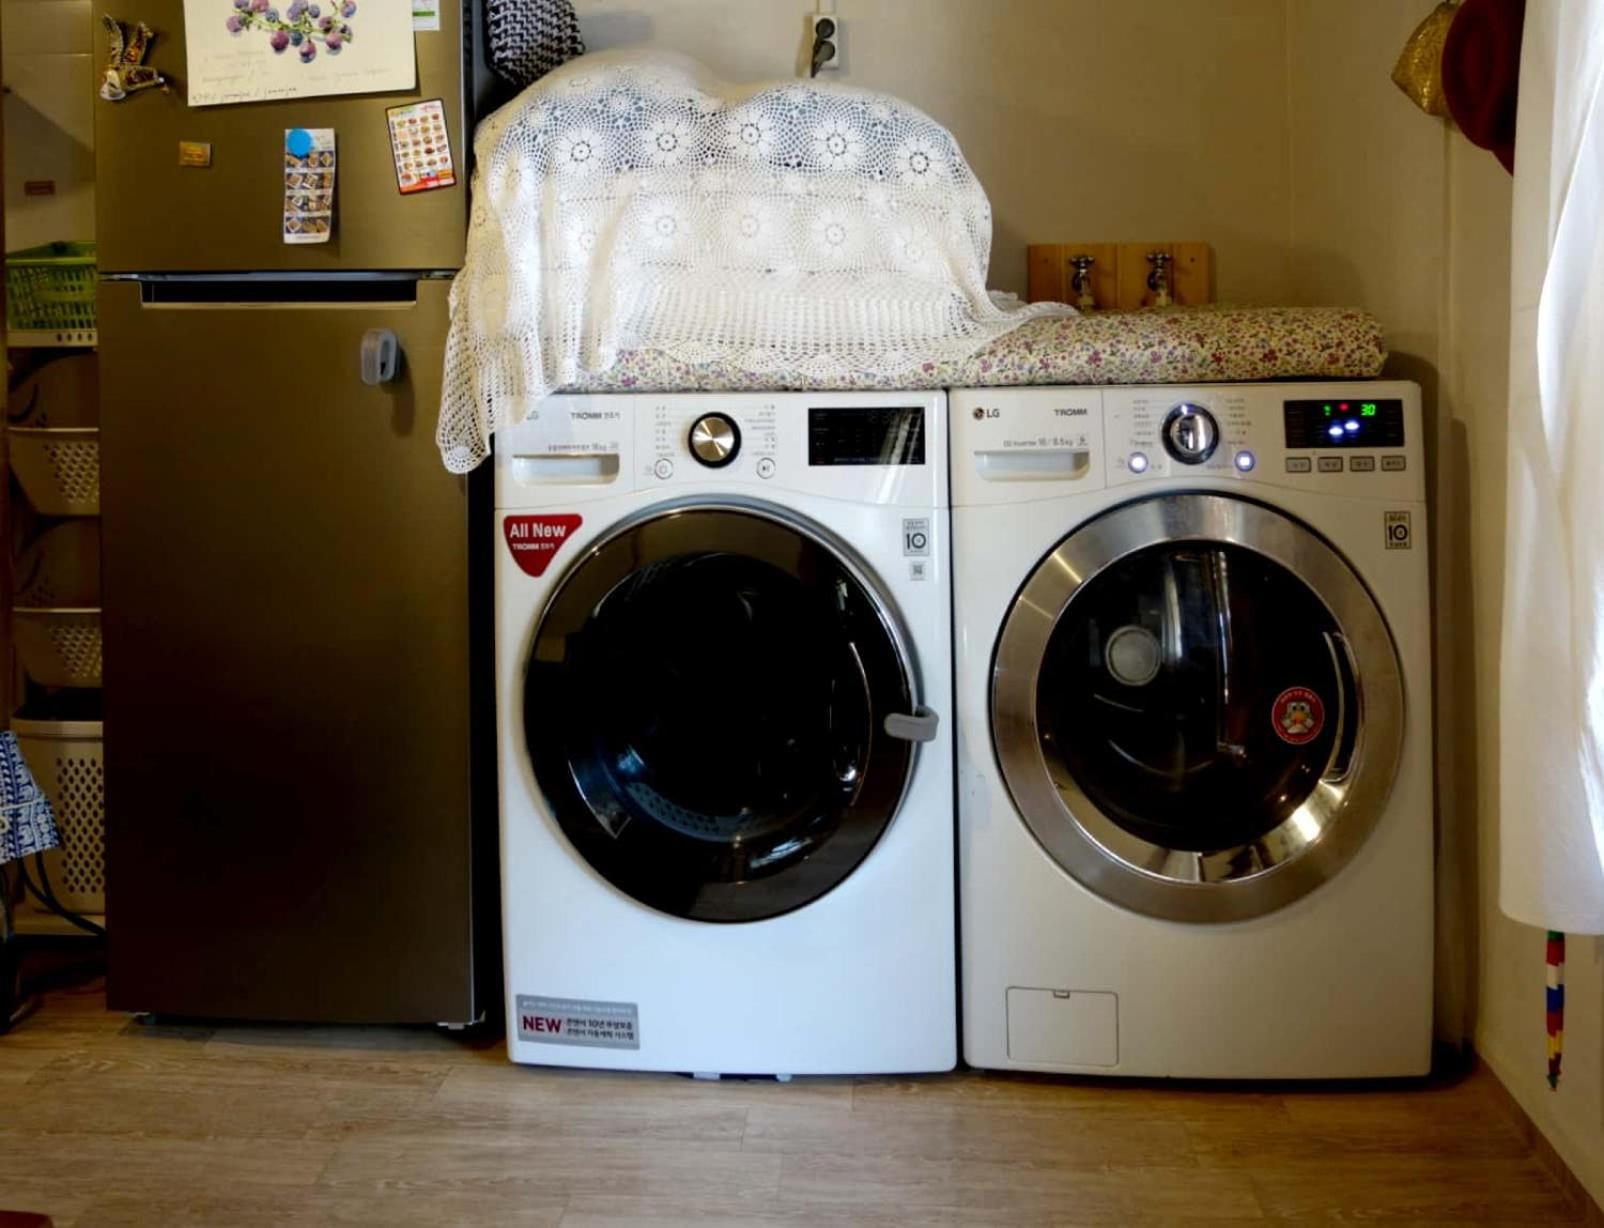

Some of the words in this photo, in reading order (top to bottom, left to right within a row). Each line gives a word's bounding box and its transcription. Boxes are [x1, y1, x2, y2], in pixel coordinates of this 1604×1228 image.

[571, 412, 602, 420] TROMM
[986, 408, 1000, 418] LG
[1054, 408, 1088, 417] TROMM
[1361, 404, 1376, 416] 30
[510, 523, 529, 538] All
[532, 523, 566, 538] New
[1389, 524, 1408, 541] 10
[906, 532, 927, 550] 10
[522, 1015, 562, 1034] NEW
[588, 1018, 606, 1029] 10년
